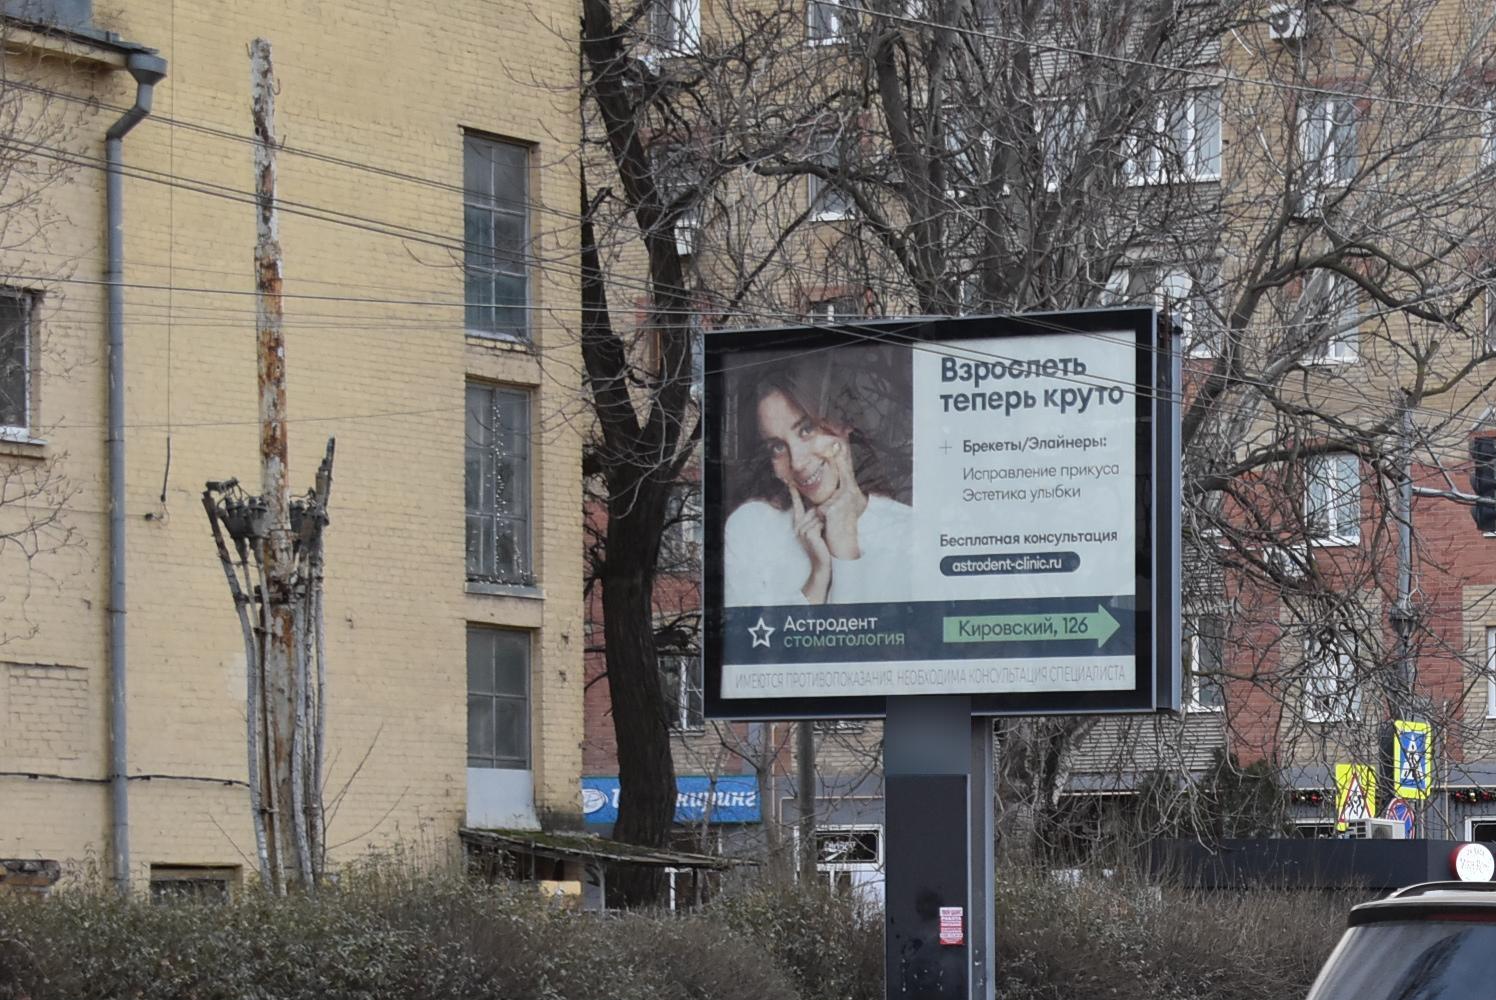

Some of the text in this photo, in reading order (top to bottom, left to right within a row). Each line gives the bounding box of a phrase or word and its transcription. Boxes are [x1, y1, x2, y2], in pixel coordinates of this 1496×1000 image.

[941, 357, 1087, 388] Взрослеть
[940, 386, 1125, 417] теперь круто
[963, 435, 1108, 456] Брекеты/Элайнеры:
[963, 464, 1120, 483] Исправление прикуса
[963, 484, 1081, 503] Эстетика улыбки
[940, 531, 1118, 547] Бесплатная консультация
[952, 555, 1063, 573] astrodent-clinic.ru
[783, 615, 879, 634] Астродент
[959, 616, 1089, 640] Кировский, 126
[783, 632, 906, 649] стоматология
[735, 672, 784, 689] ИМЕЮТСЯ
[896, 668, 966, 687] НЕОБХОДИМА
[968, 666, 1048, 684] КОНСУЛЬТАЦИЯ
[1050, 664, 1125, 682] СПЕЦИАЛИСТА
